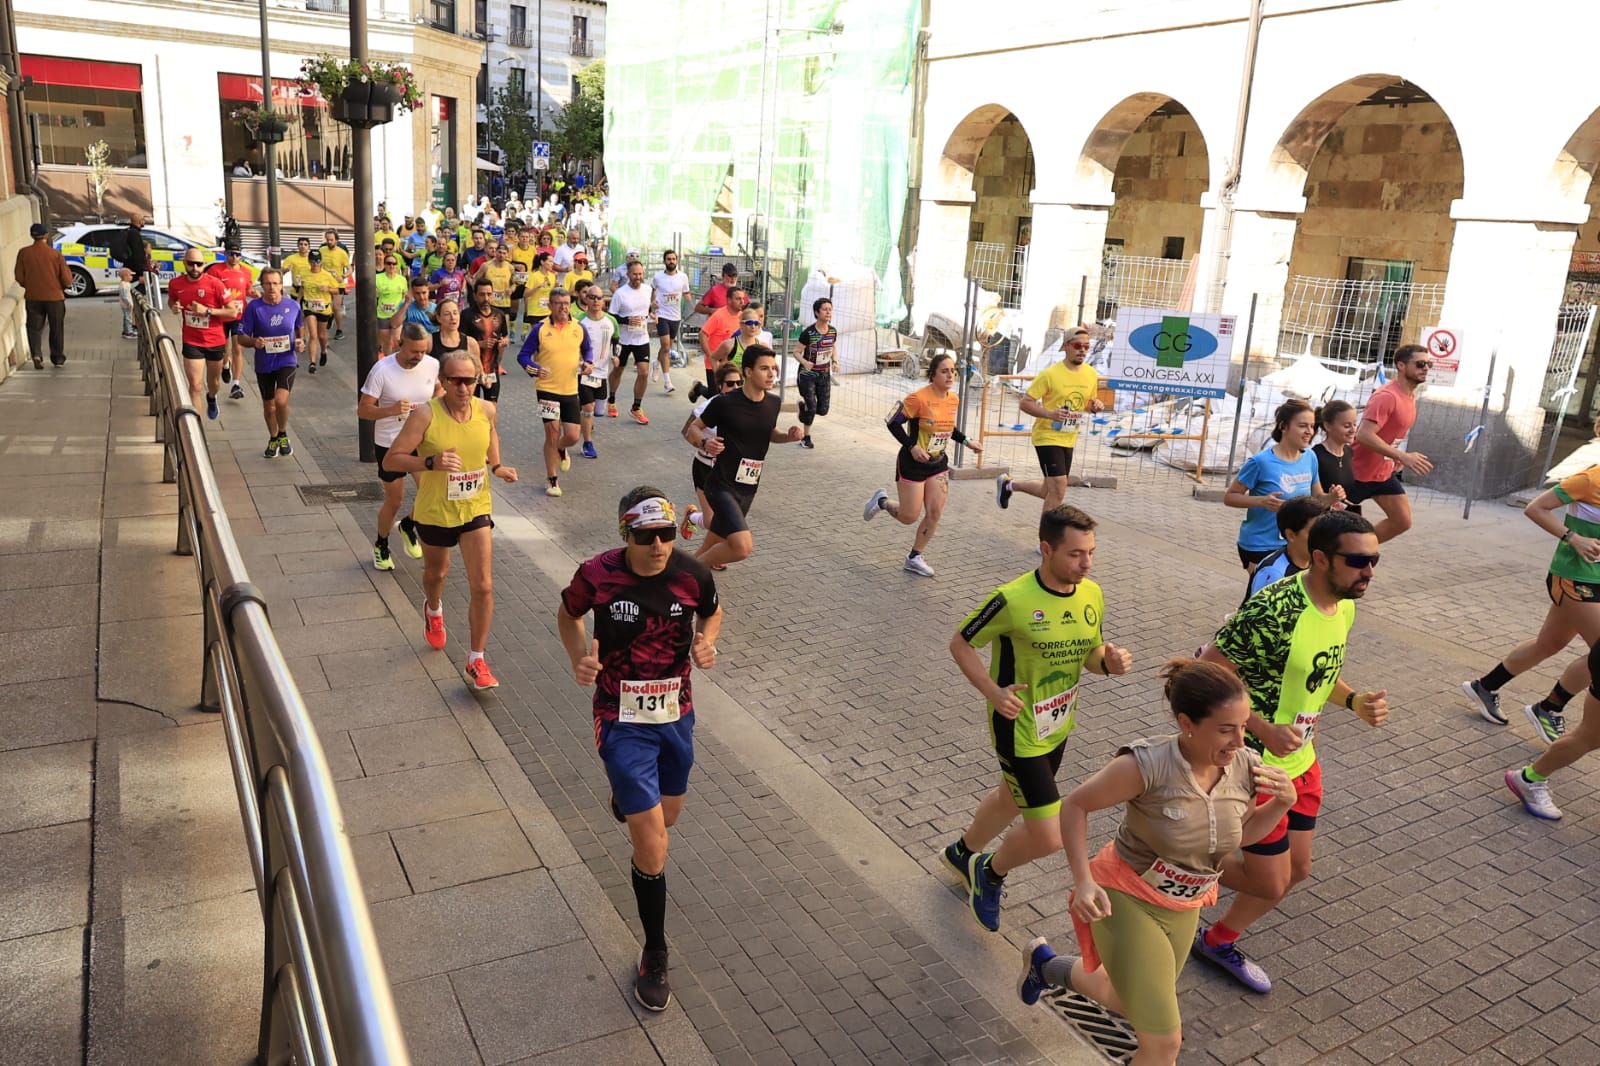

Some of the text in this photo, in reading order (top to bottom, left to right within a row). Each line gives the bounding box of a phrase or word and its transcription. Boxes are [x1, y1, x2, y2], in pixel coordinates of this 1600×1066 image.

[272, 340, 283, 349] 42
[1153, 331, 1193, 353] CG
[1123, 366, 1215, 384] CONGESA XXI
[541, 406, 555, 414] 294
[458, 479, 478, 492] 181
[621, 681, 680, 695] bedunia
[635, 693, 666, 711] 131
[1051, 703, 1068, 721] 99
